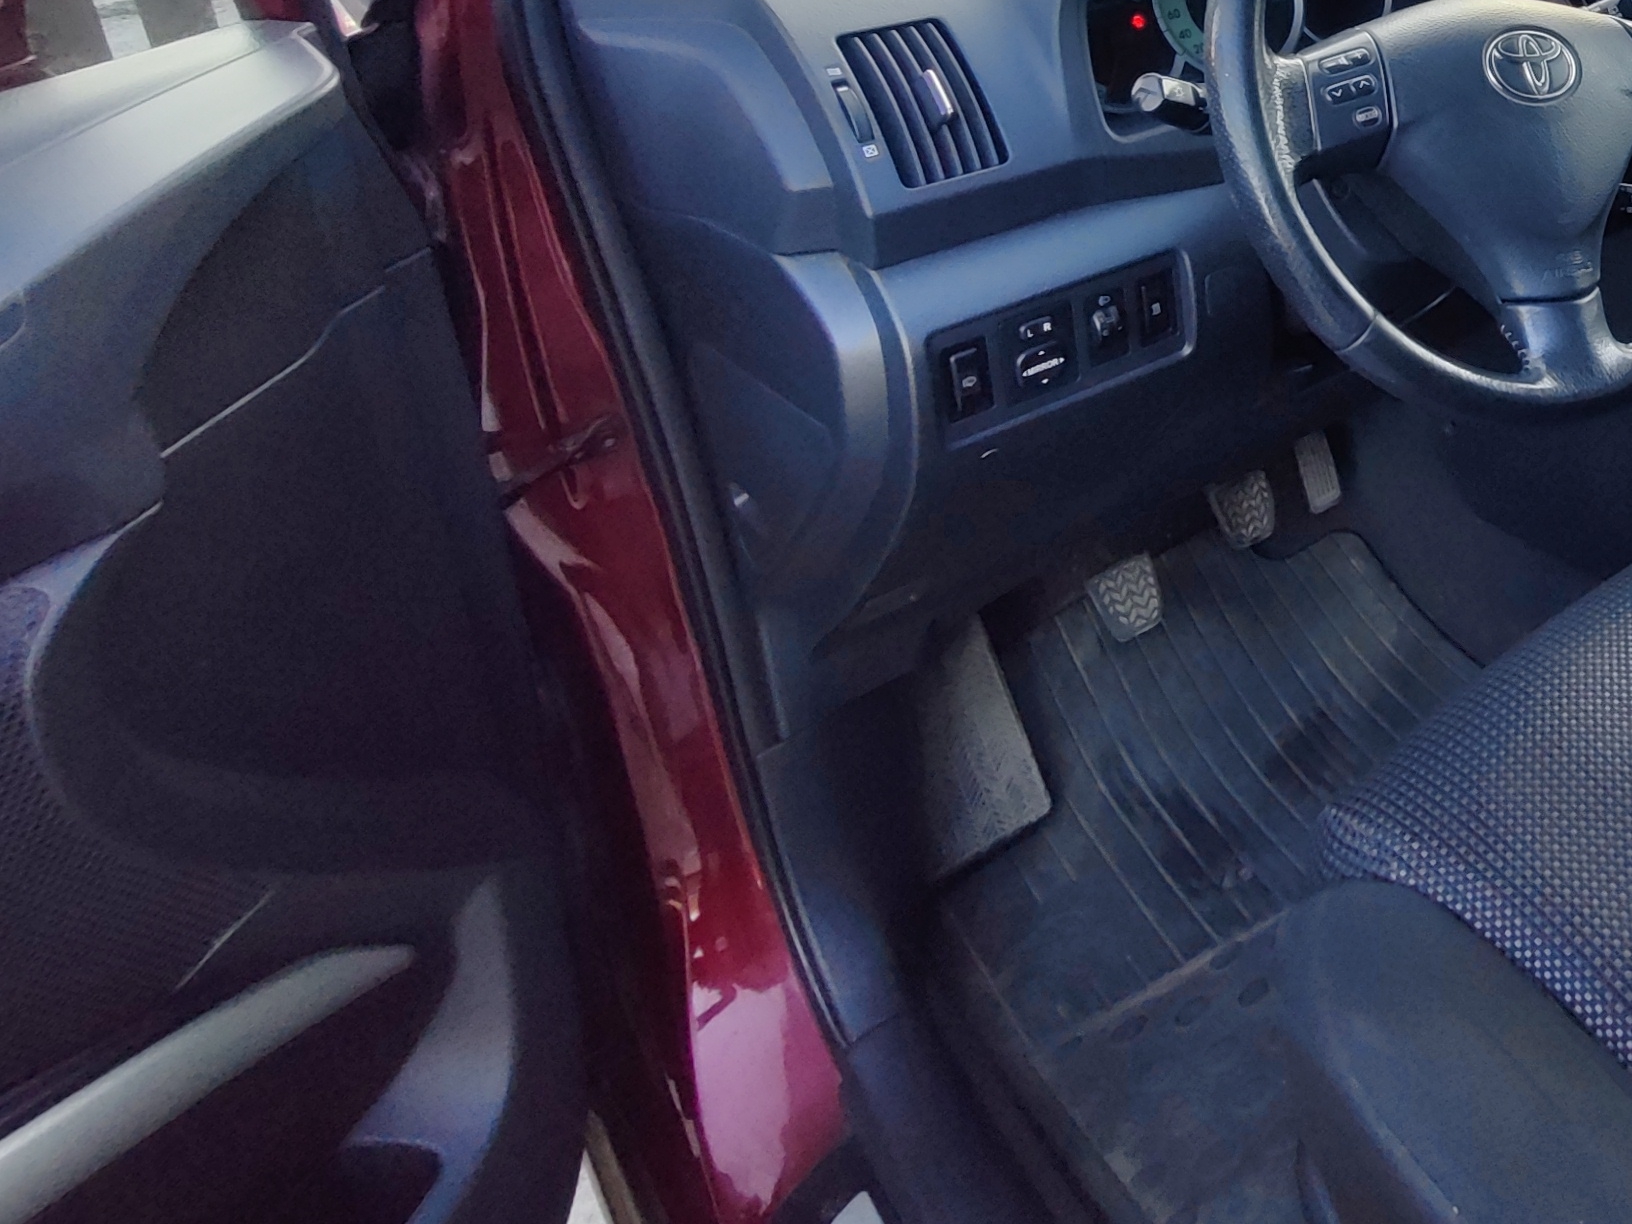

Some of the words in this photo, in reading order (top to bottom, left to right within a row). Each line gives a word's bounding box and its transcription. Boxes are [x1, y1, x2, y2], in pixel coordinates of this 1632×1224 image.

[1167, 8, 1181, 20] 60
[1179, 28, 1192, 40] 40
[1027, 329, 1034, 338] L
[1043, 322, 1052, 332] R
[1027, 358, 1059, 376] MIRROR
